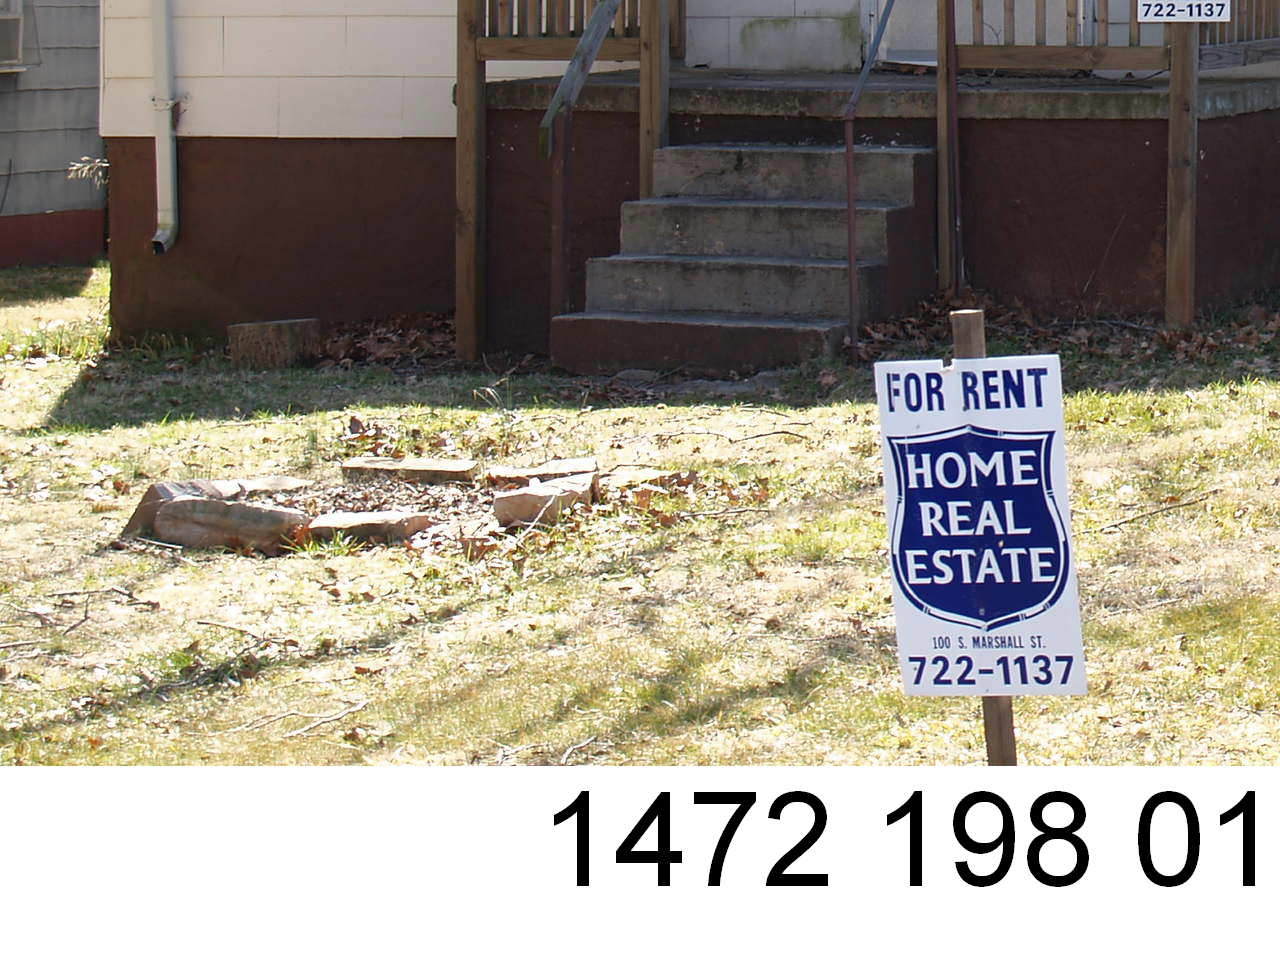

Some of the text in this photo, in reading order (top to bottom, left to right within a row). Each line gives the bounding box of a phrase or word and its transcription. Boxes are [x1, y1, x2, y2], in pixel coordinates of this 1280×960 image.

[1142, 3, 1225, 17] 722-1137
[887, 368, 1048, 412] FOR RENT
[906, 450, 1039, 489] HOME
[919, 500, 1032, 537] REAL
[905, 547, 1057, 585] ESTATE
[933, 636, 951, 649] 100
[972, 636, 1024, 649] MARSHALL
[1030, 636, 1047, 649] ST.
[908, 655, 1074, 686] 722-1137
